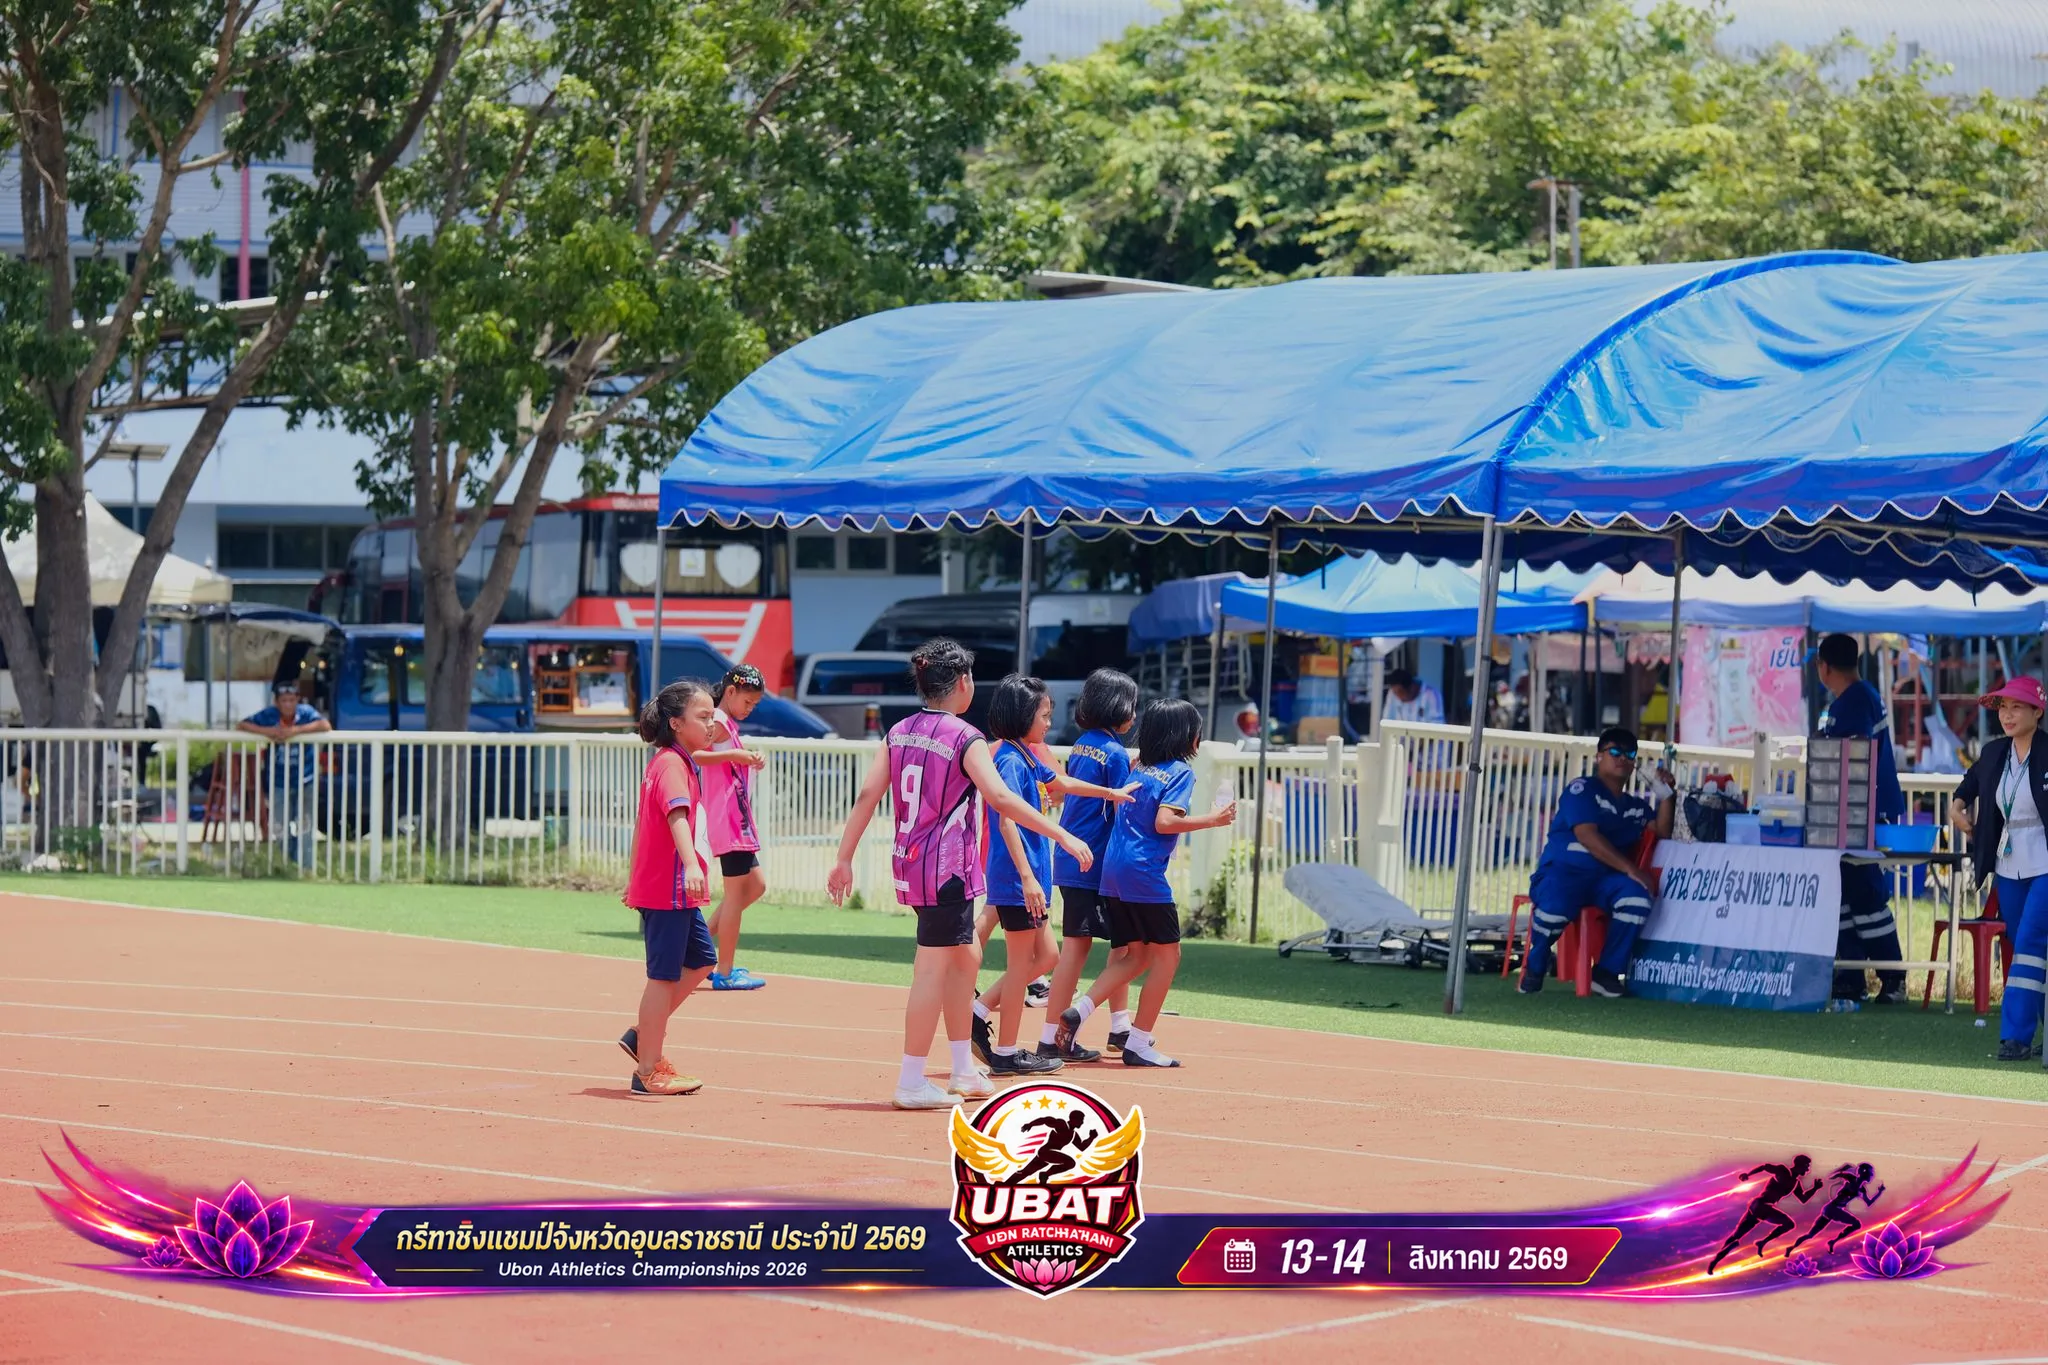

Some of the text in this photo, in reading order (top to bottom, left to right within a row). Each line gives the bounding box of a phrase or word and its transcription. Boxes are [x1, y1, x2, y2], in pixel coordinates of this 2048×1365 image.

[899, 764, 924, 834] 9
[1663, 854, 1820, 919] หน่วยปฐมพยาบาล
